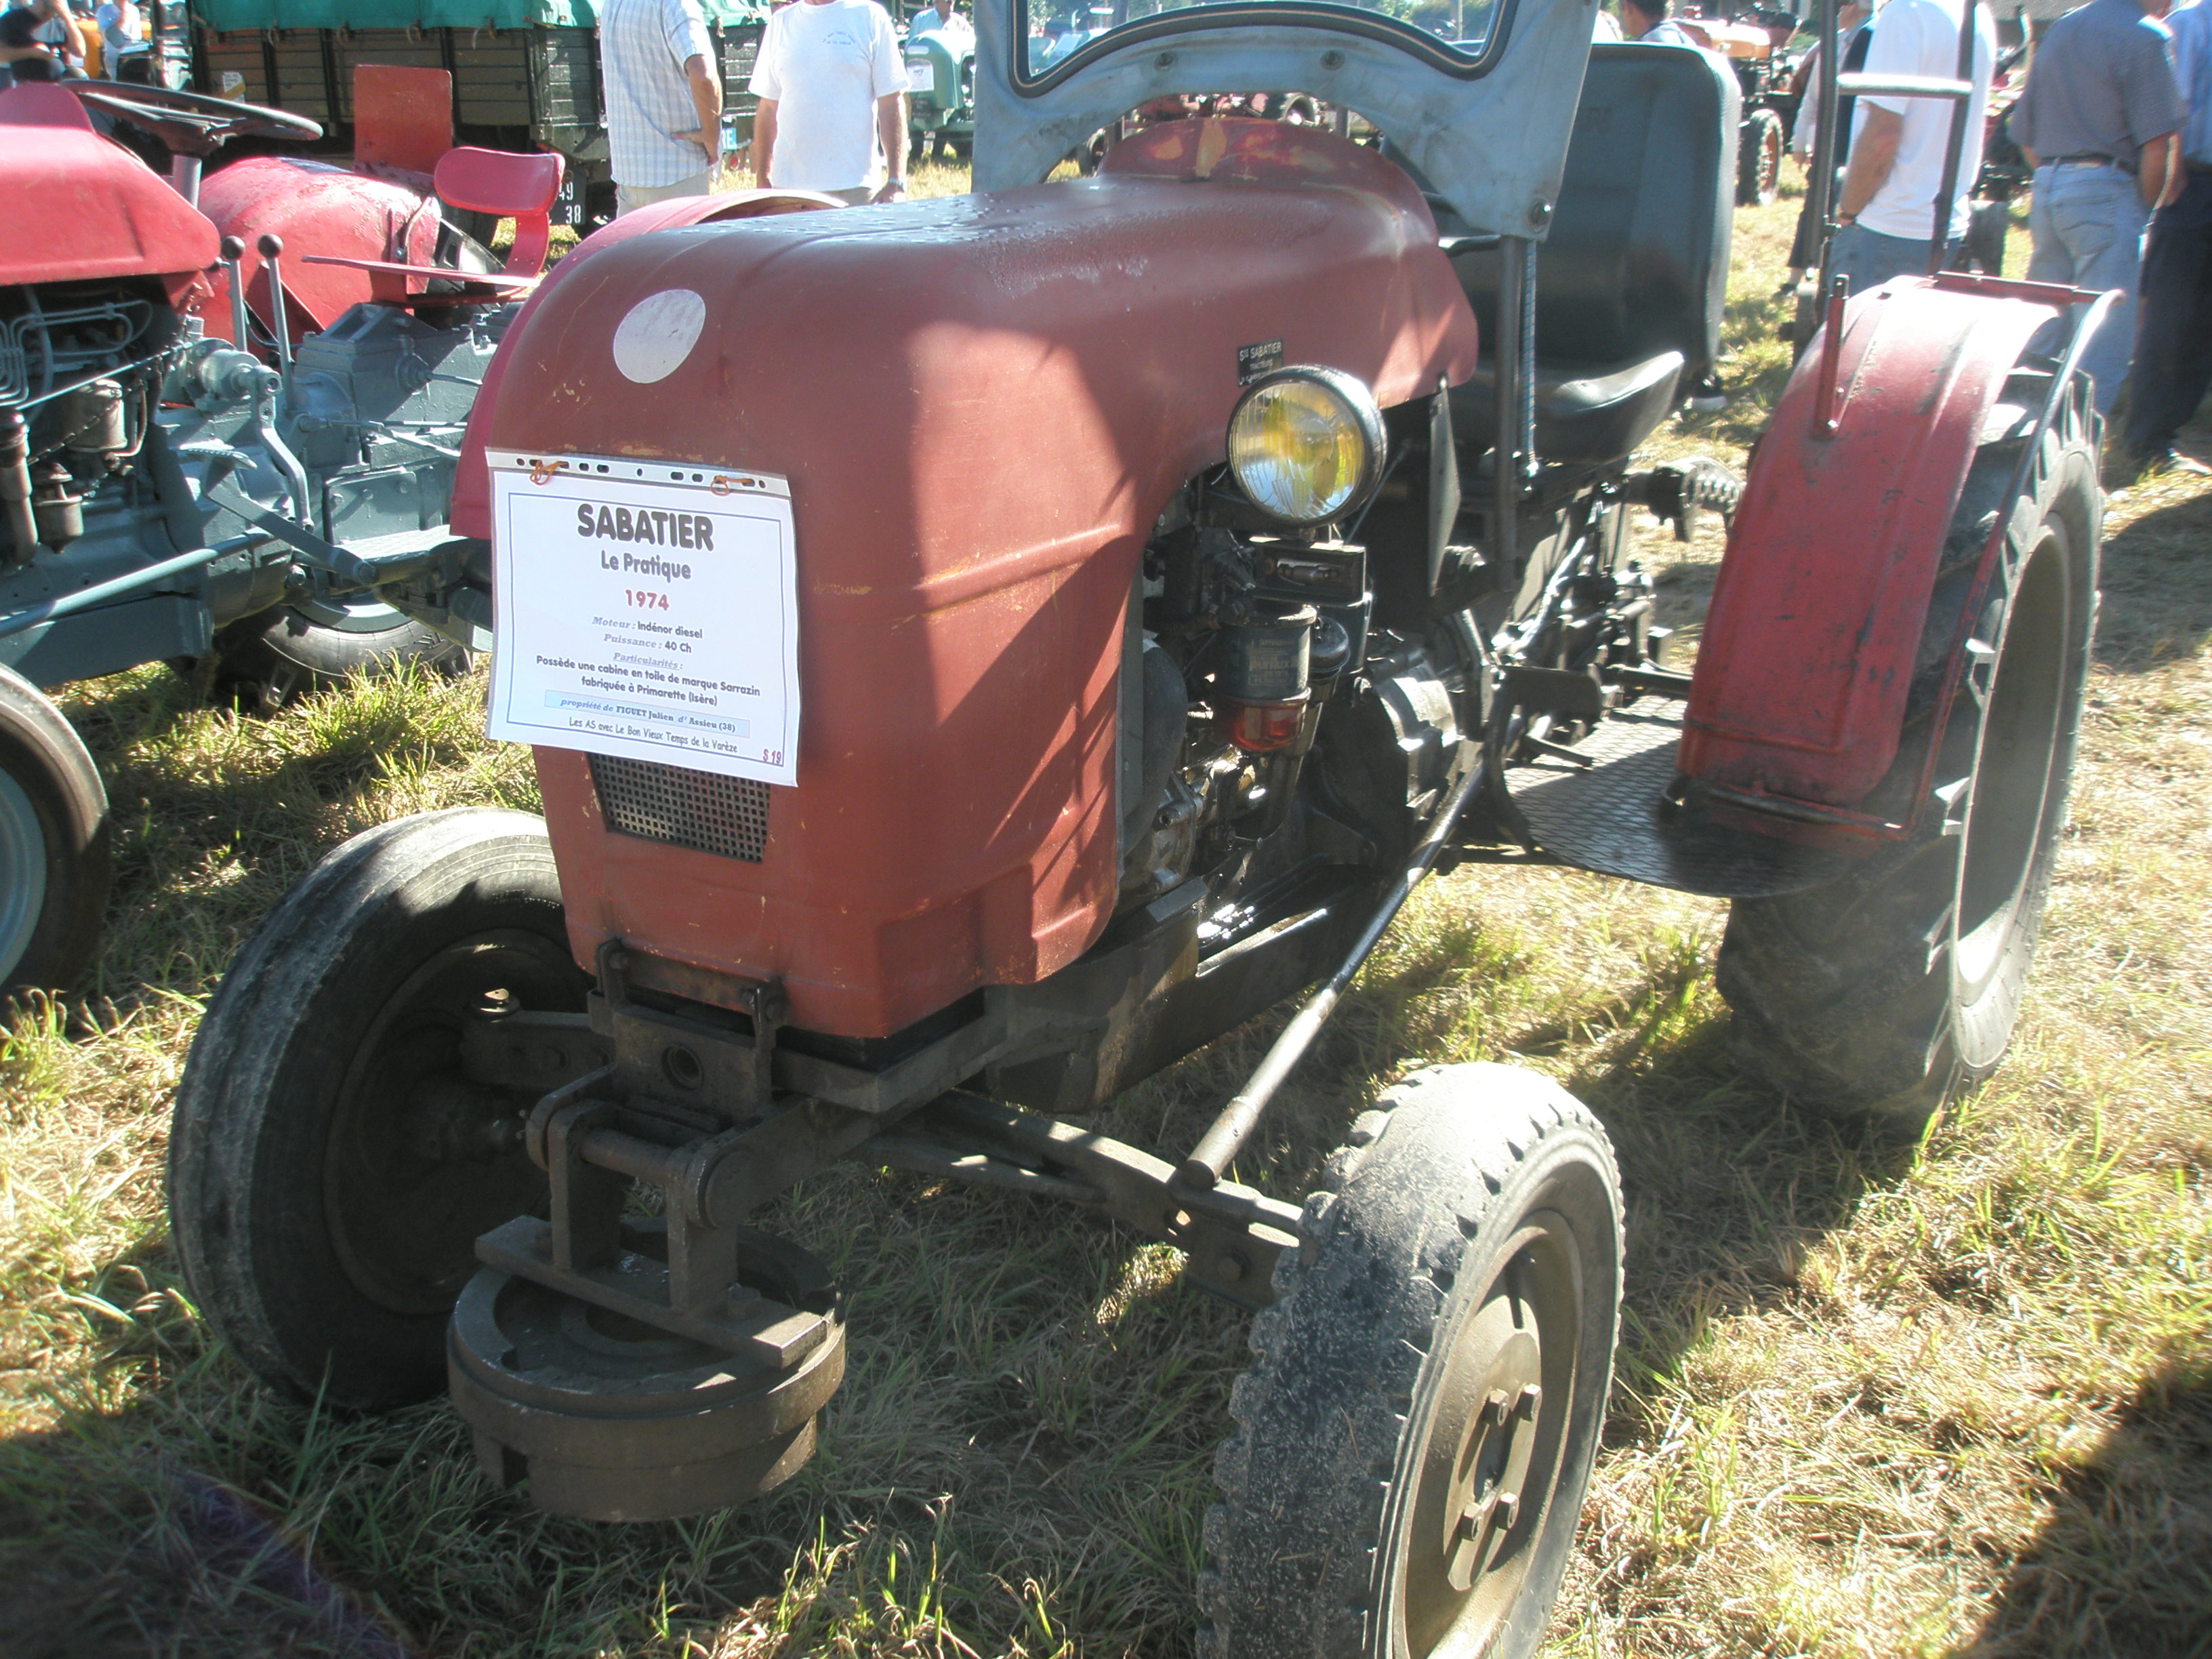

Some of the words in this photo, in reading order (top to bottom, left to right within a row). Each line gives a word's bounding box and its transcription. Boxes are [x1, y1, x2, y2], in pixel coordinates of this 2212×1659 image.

[565, 205, 581, 224] 38
[1250, 342, 1282, 359] SABATIER
[578, 504, 714, 552] SABATIER
[601, 550, 619, 570] Le
[623, 553, 691, 583] Pratique
[626, 590, 670, 611] 1974
[638, 621, 672, 634] Indénor
[675, 626, 703, 638] diesel
[604, 634, 657, 648] Puissance
[665, 640, 677, 651] 40
[680, 643, 691, 653] Ch
[537, 655, 575, 668] Possède
[578, 662, 595, 671] une
[598, 664, 628, 676] cabine
[645, 670, 665, 681] toile
[668, 673, 679, 683] de
[682, 678, 718, 691] marque
[720, 682, 760, 696] Sarrazin
[581, 676, 626, 691] fabriquée
[628, 682, 634, 693] à
[637, 684, 686, 701] Primarette
[689, 691, 718, 706] (Isère)
[560, 699, 601, 710] propriété
[649, 711, 674, 721] Julien
[689, 718, 717, 729] Assieu
[718, 722, 735, 733] (38)
[569, 717, 582, 727] Les
[586, 720, 596, 729] AS
[598, 724, 613, 732] avec
[616, 724, 624, 734] Le
[628, 726, 640, 736] Bon
[643, 729, 663, 739] Vieux
[666, 732, 688, 746] Temps
[691, 736, 699, 746] de
[703, 738, 709, 747] la
[712, 739, 737, 752] Varèze
[771, 750, 781, 764] 19
